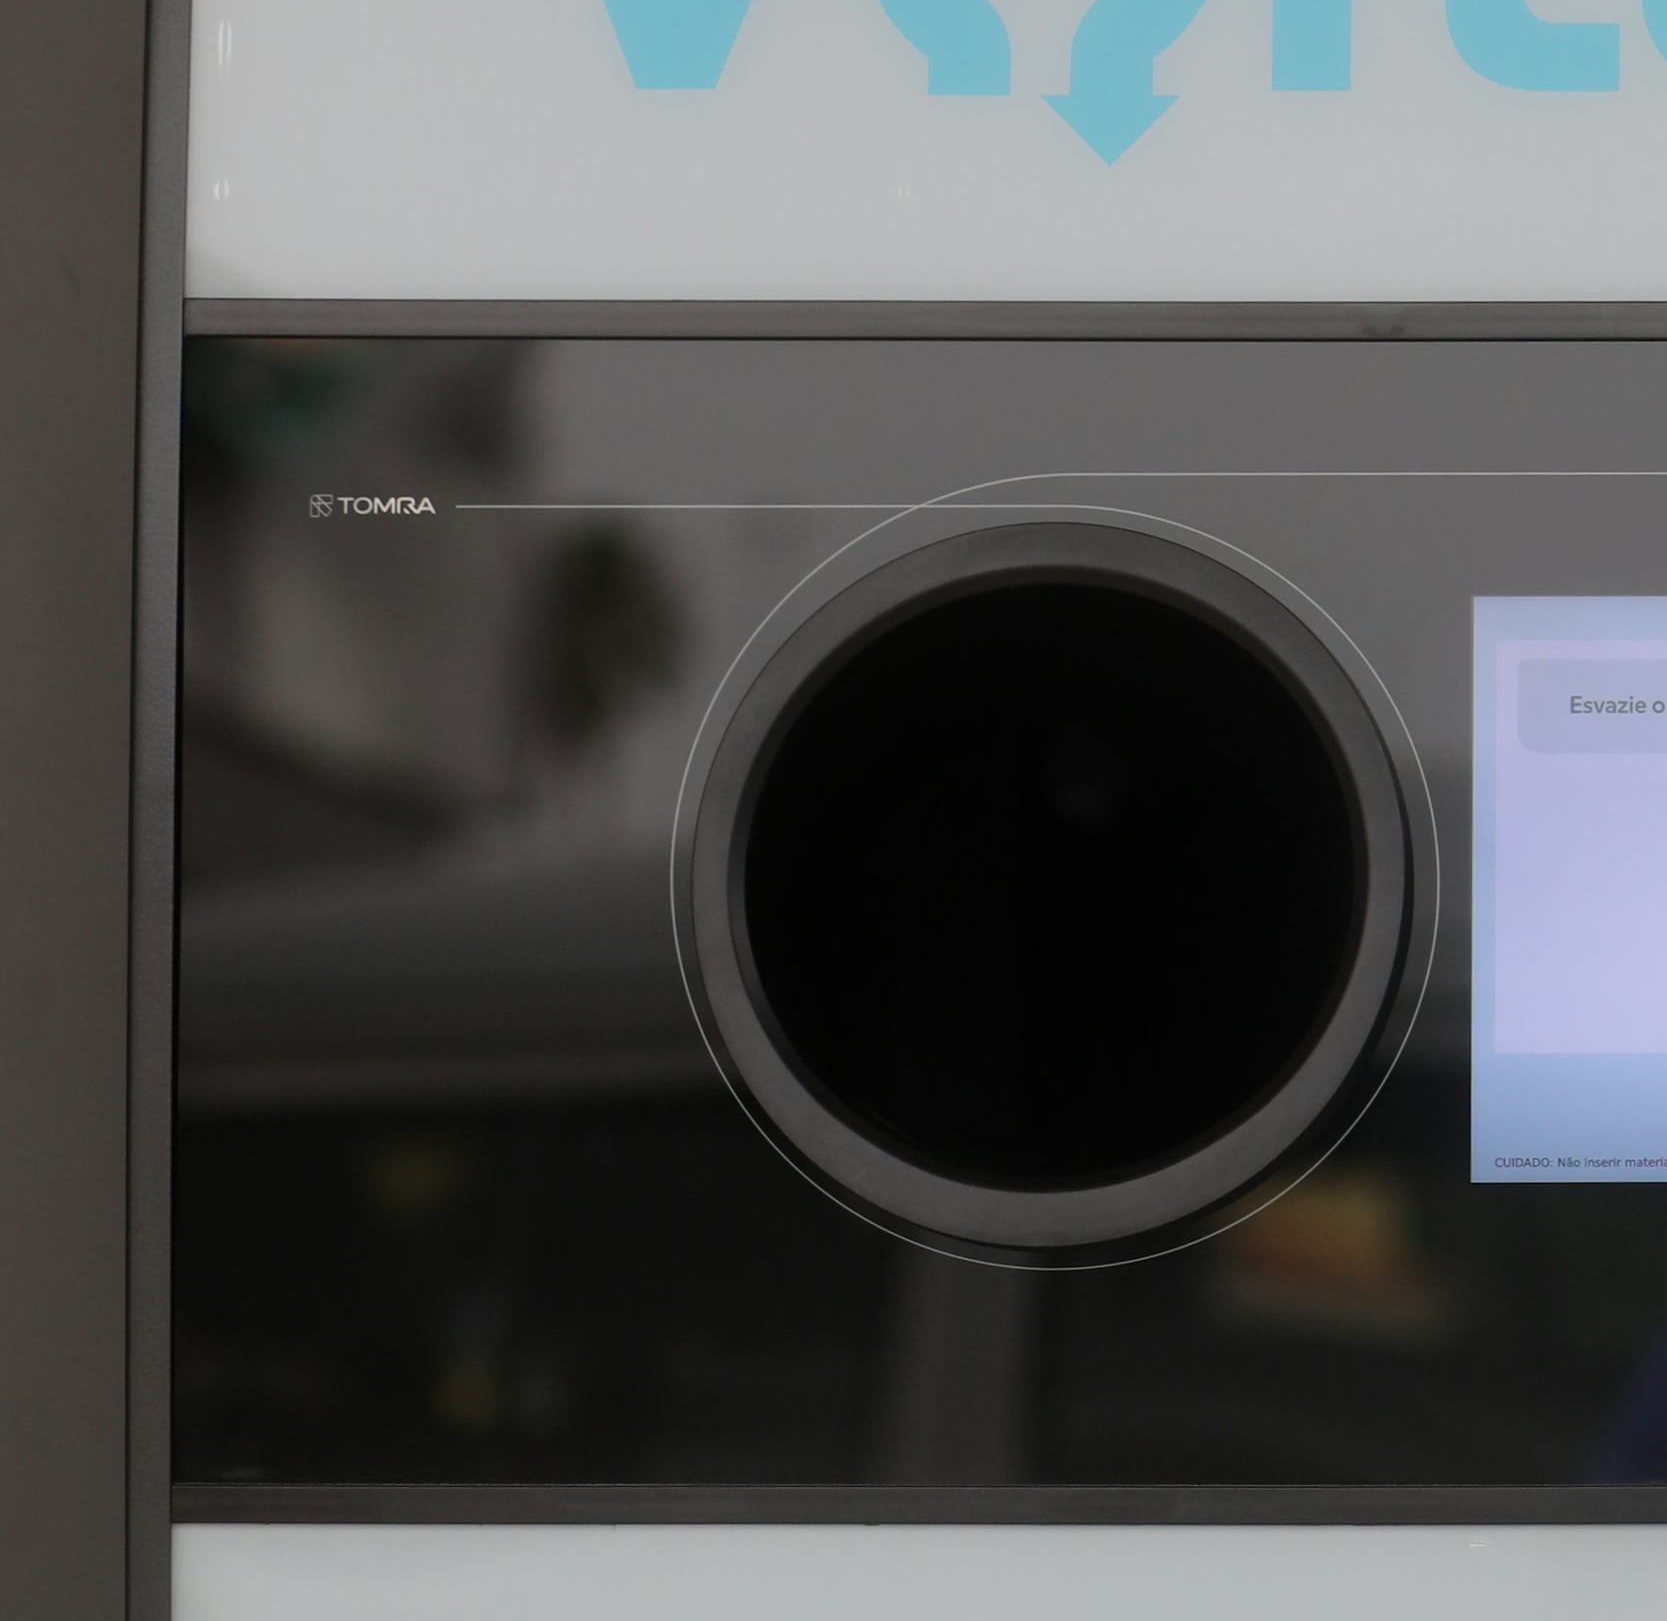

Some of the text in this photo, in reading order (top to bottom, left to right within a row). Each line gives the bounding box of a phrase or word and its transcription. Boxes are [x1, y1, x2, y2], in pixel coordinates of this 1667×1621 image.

[337, 496, 436, 515] TOMRA
[1570, 695, 1647, 714] Esvazie
[1652, 700, 1666, 714] o
[1494, 1157, 1553, 1168] CUIDADO:
[1557, 1157, 1581, 1168] Não
[1584, 1158, 1622, 1168] inserir
